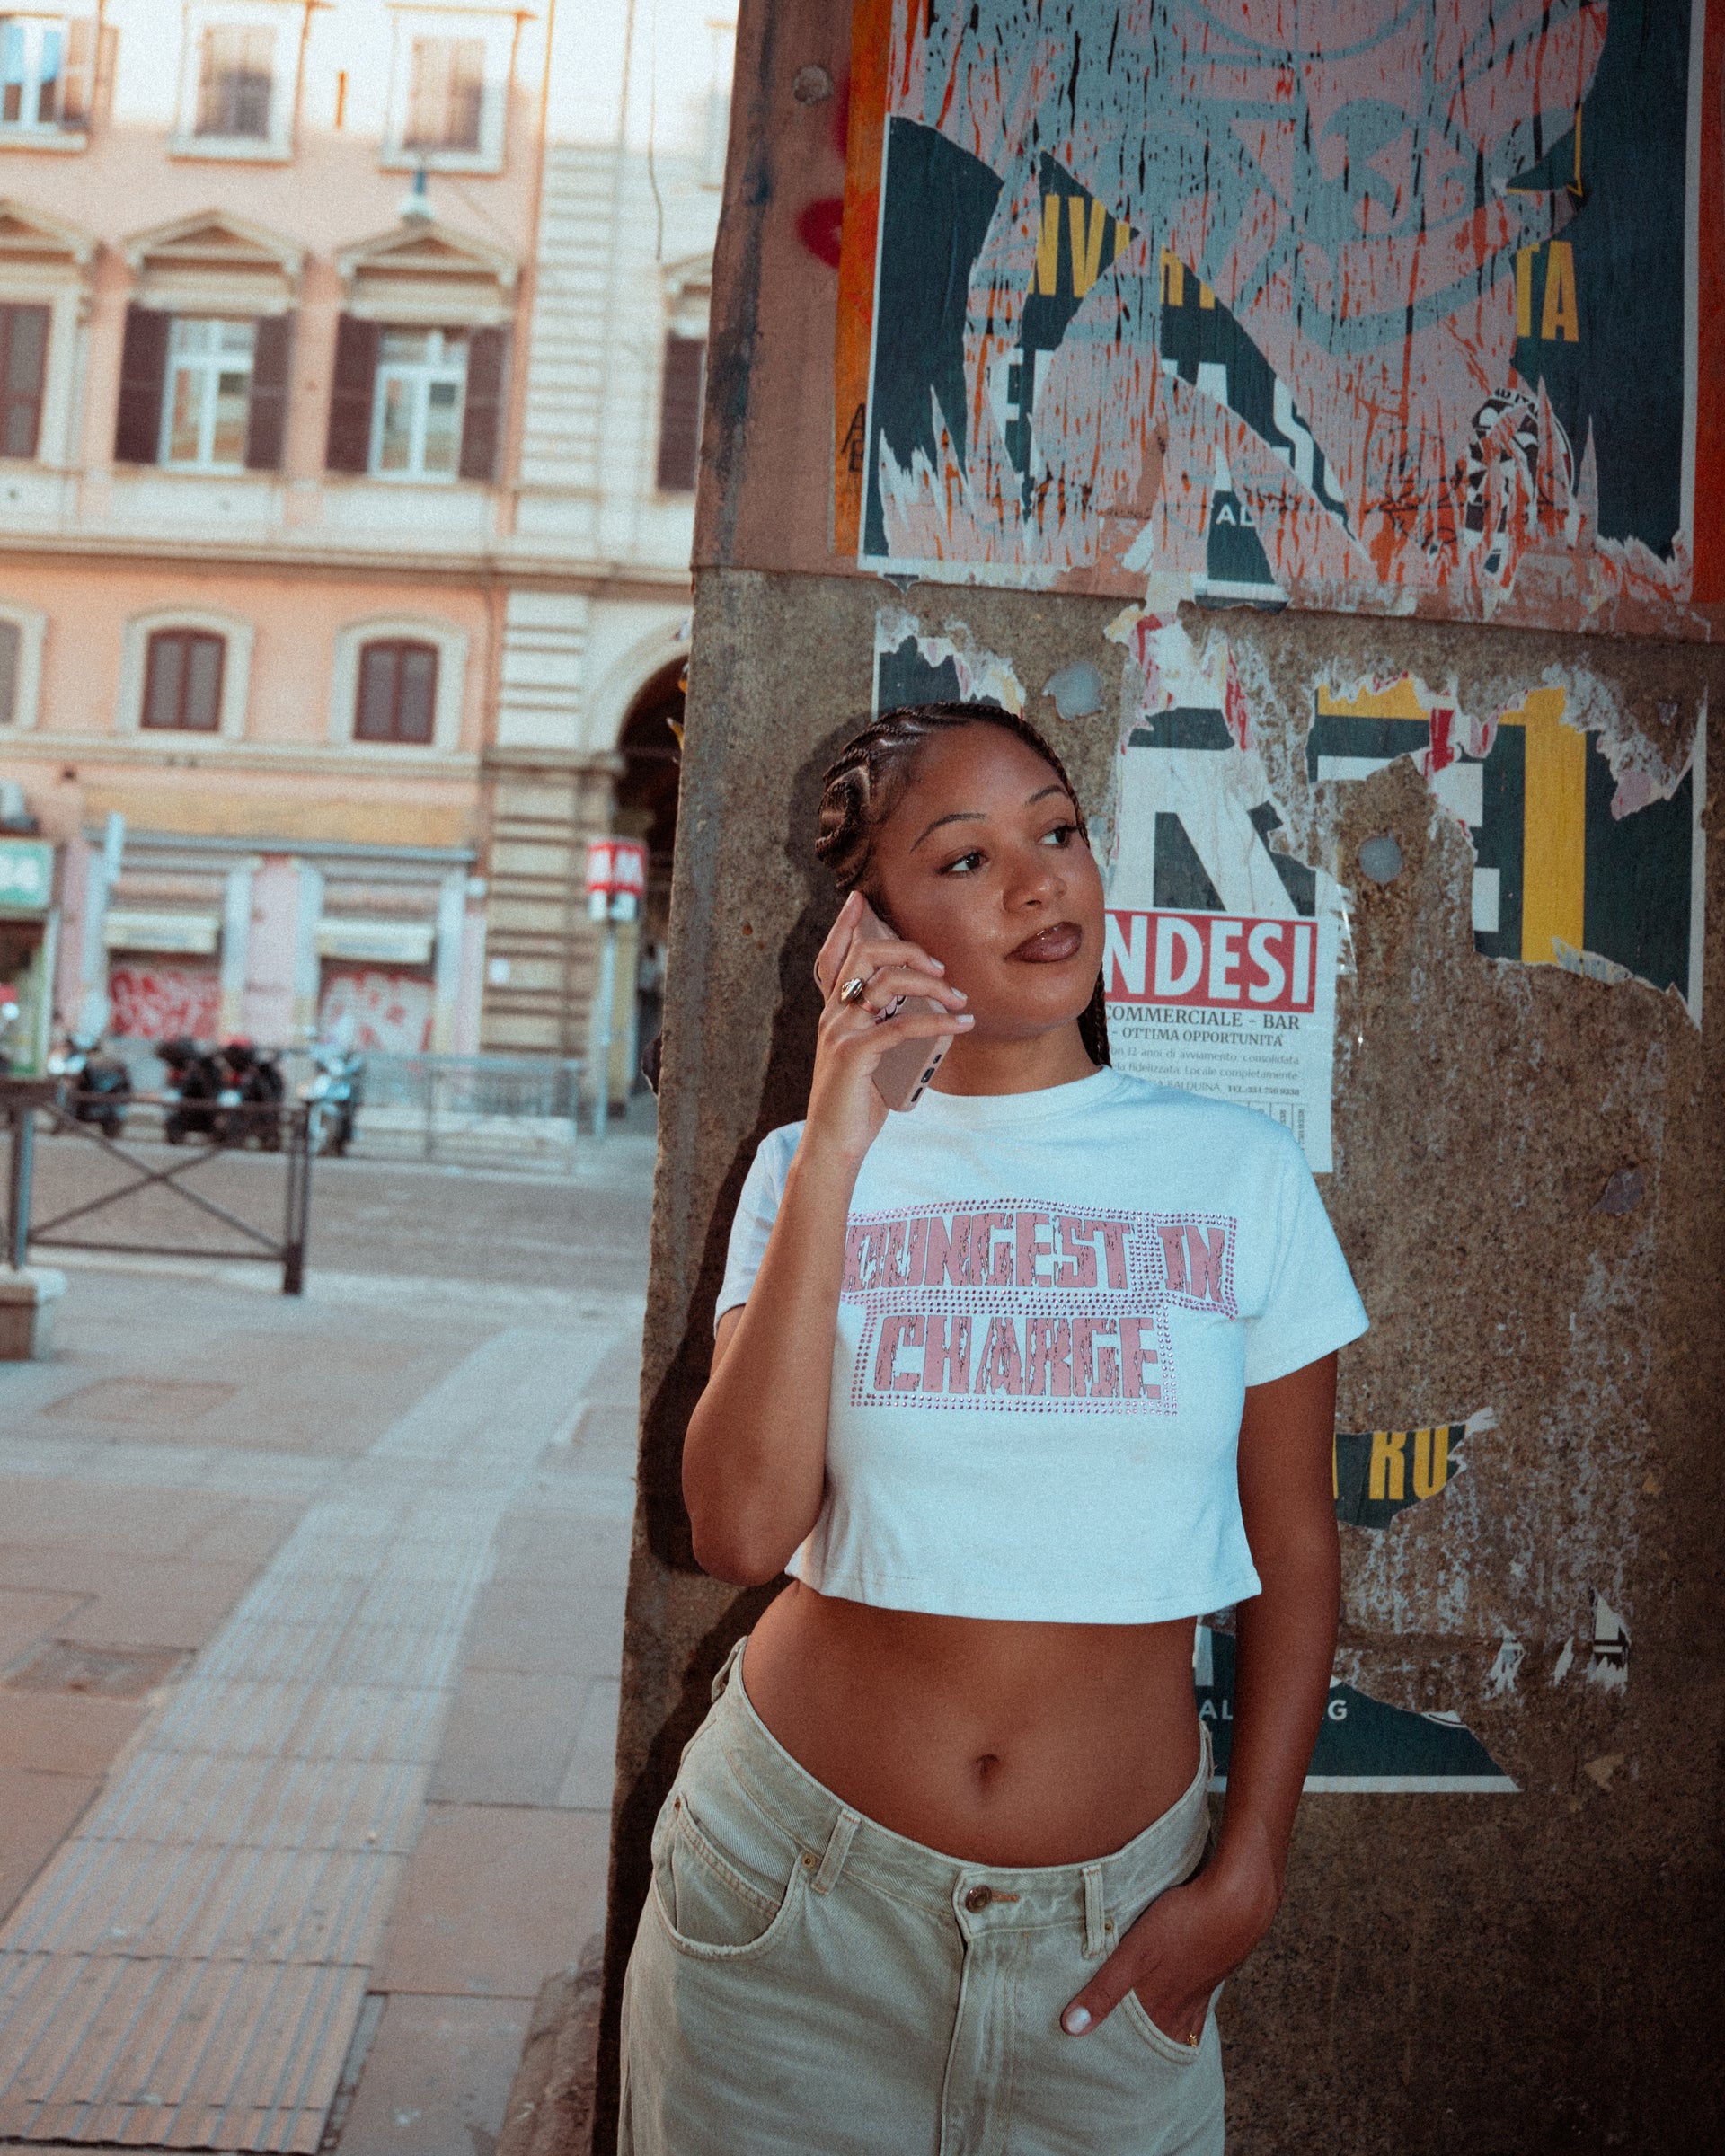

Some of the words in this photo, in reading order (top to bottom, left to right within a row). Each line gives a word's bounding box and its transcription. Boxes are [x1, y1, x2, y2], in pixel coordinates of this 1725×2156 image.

[1104, 914, 1311, 1003] NDESI
[1263, 1014, 1300, 1030] BAR
[1122, 1027, 1179, 1041] OTTIMA
[1183, 1030, 1284, 1047] OPPORTUNITÀ
[1141, 1048, 1163, 1058] anni
[1166, 1047, 1175, 1058] di
[1219, 1068, 1299, 1081] completamente
[1156, 1225, 1225, 1303] IN
[874, 1314, 1162, 1399] CHARGE
